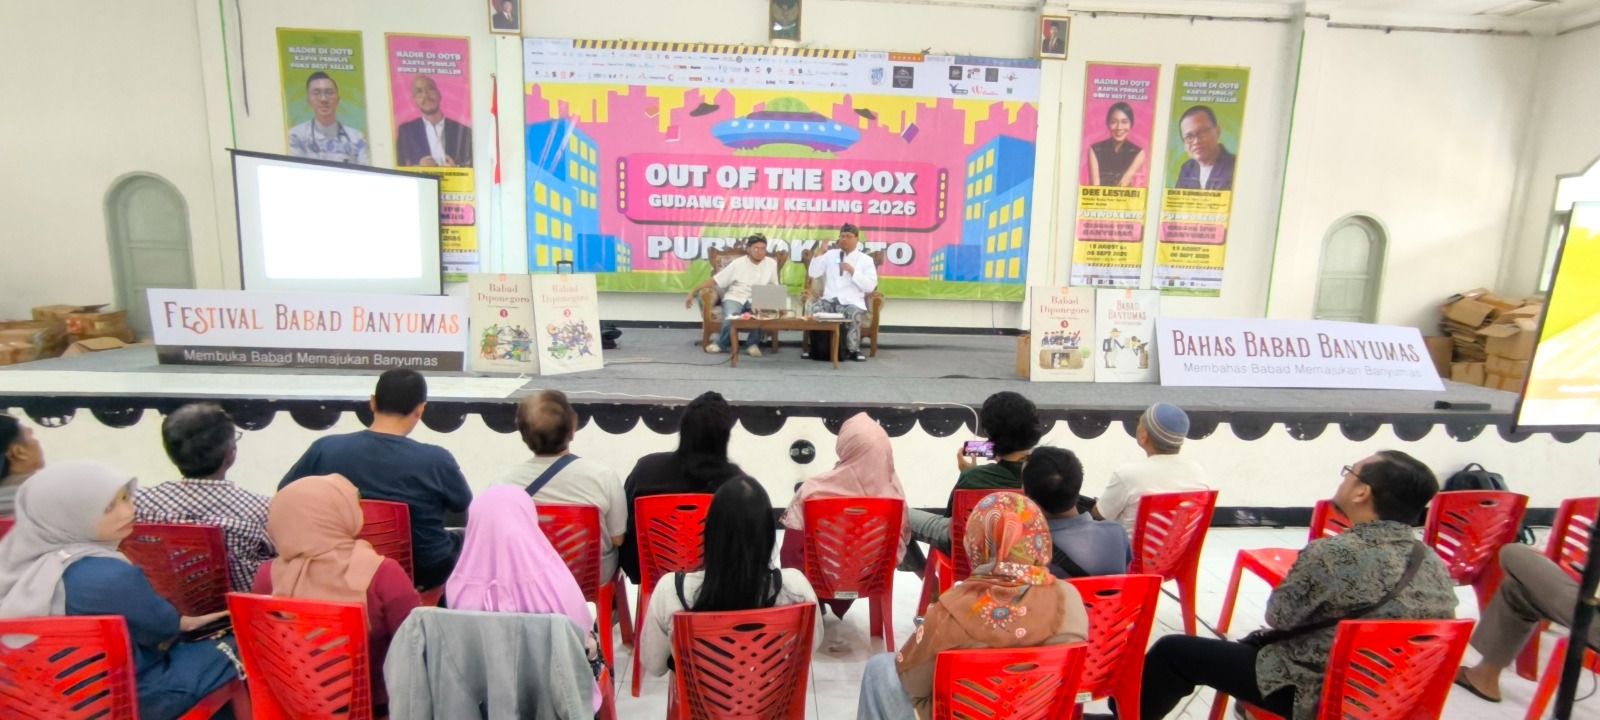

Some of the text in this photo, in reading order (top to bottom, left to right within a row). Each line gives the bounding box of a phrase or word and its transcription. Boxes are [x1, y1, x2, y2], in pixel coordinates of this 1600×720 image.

[645, 163, 916, 194] OUT OF THE BOOX
[1082, 188, 1140, 198] DEE LESTARI
[648, 194, 916, 215] GUDANG BUKU KELILING 2026
[489, 283, 518, 293] Babad
[552, 284, 579, 293] Babad
[477, 292, 530, 304] Diponegoro
[541, 294, 590, 305] Diponegoro
[1051, 295, 1079, 305] Babad
[1040, 304, 1090, 316] Diponegoro
[1108, 309, 1147, 320] BANYUMAS
[164, 301, 460, 334] FESTIVAL BABAD BANYUMAS
[1172, 329, 1421, 363] BAHAS BABAD BANYUMAS
[184, 349, 438, 368] Membuka Babad Memajukan Banyumas
[1183, 362, 1421, 379] Membahas Babad Memajukan Banyumas
